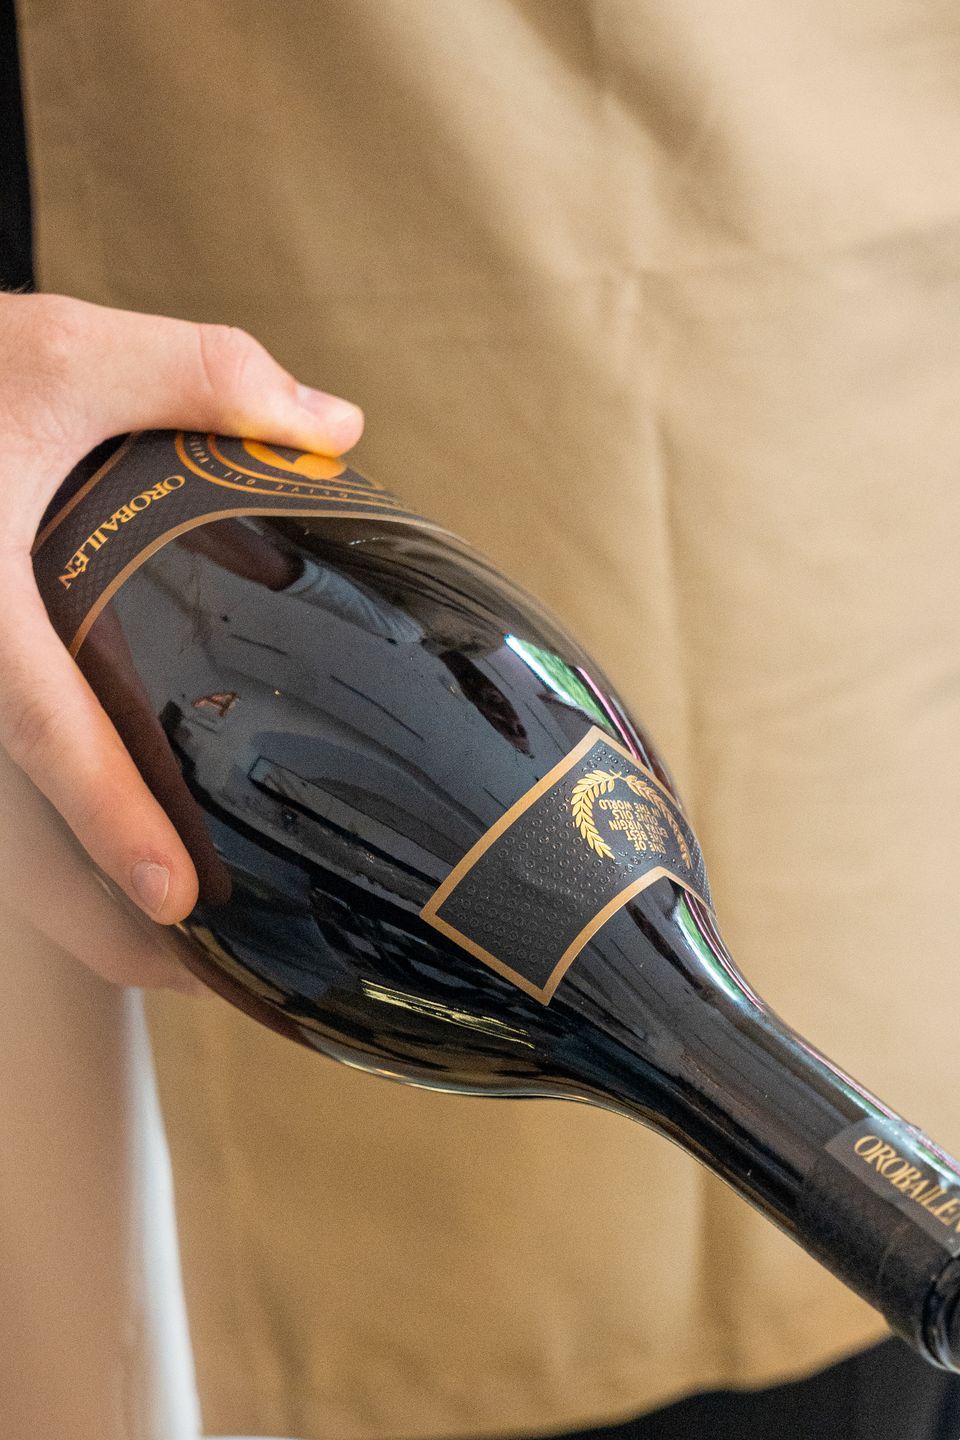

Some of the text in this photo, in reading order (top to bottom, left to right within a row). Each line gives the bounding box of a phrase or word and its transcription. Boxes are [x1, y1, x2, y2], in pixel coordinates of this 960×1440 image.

[58, 474, 185, 589] OROBAILÉN
[598, 799, 634, 811] WORLD
[633, 802, 651, 815] THE
[611, 809, 659, 826] OLIVE OILS
[608, 819, 669, 838] EXTRA VIRGIN
[625, 829, 648, 841] BEST
[633, 840, 667, 854] ONE OF
